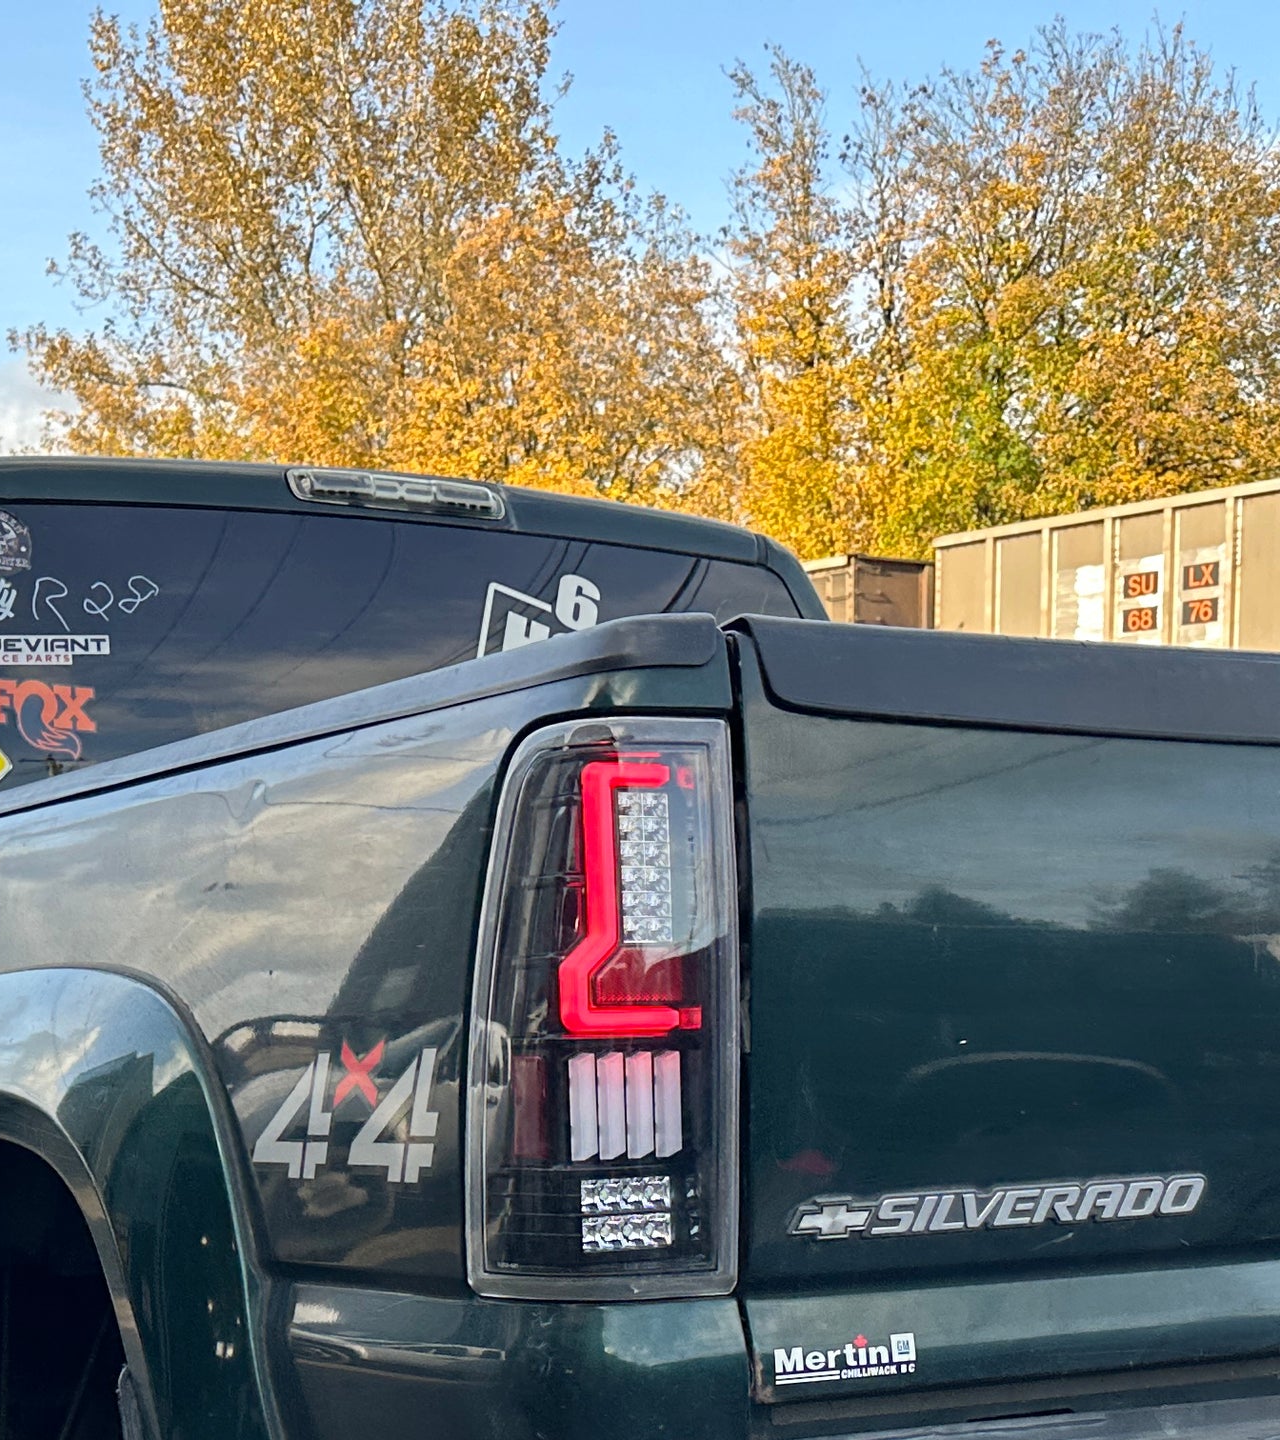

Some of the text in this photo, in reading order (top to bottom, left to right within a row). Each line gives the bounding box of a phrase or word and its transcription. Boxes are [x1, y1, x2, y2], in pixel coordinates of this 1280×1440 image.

[1128, 564, 1215, 597] SU LX
[1127, 600, 1213, 631] 68 76
[26, 654, 71, 663] PARTS
[871, 1176, 1207, 1235] SILVERADO
[773, 1336, 890, 1373] Mertin
[897, 1340, 910, 1352] GM
[841, 1367, 898, 1379] CHILLIWACK
